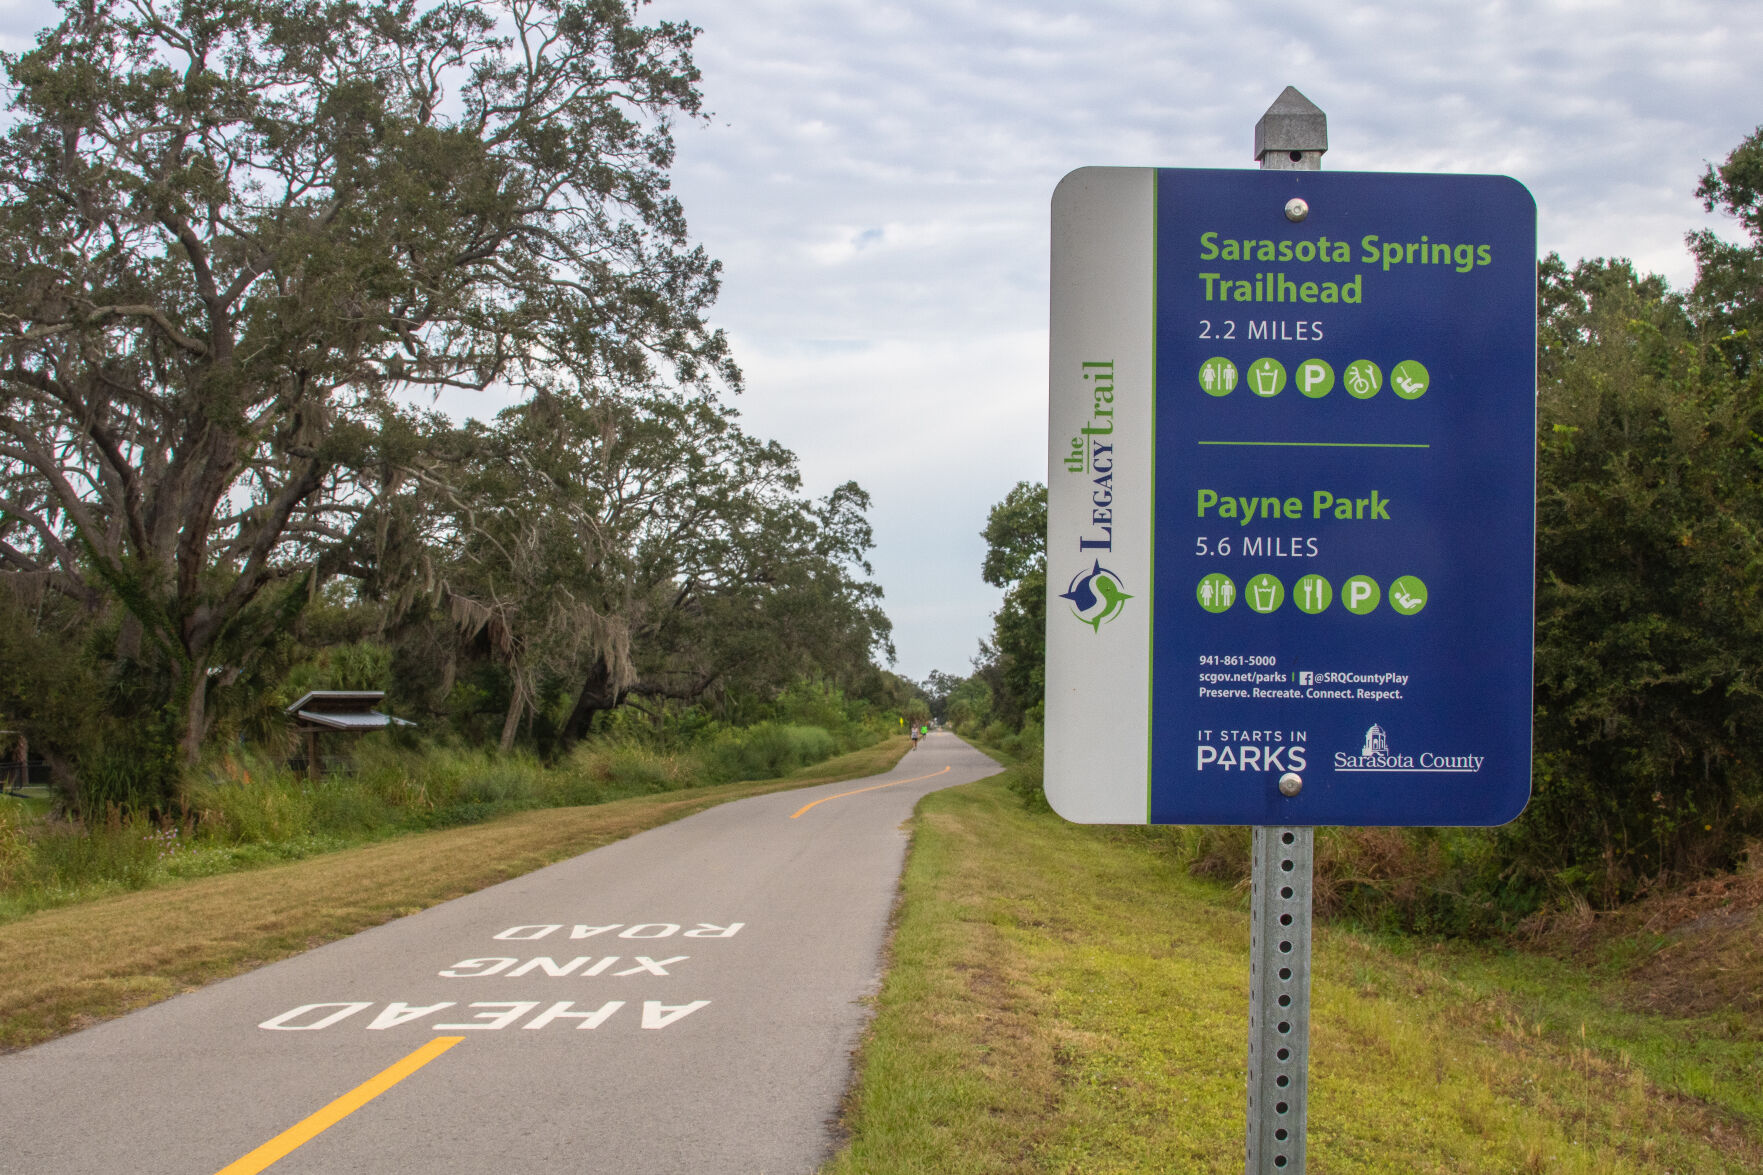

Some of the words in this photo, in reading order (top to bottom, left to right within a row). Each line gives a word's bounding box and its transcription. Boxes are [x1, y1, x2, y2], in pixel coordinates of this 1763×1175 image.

[1199, 231, 1351, 263] Sarasota
[1361, 234, 1492, 273] Springs
[1198, 272, 1363, 304] Trailhead
[1198, 319, 1236, 340] 2.2
[1247, 320, 1324, 341] MILES
[1081, 358, 1114, 435] trail
[1064, 436, 1084, 475] the
[1197, 488, 1303, 527] Payne
[1313, 489, 1391, 520] Park
[1195, 536, 1232, 557] 5.6
[1242, 537, 1319, 558] MILES
[1199, 655, 1276, 666] 941-861-5000
[1199, 671, 1287, 684] scgov.net/parks
[1314, 672, 1409, 686] @SRQCountyPlay
[1199, 687, 1250, 698] Preserve.
[1252, 687, 1304, 699] Recreate.
[1306, 688, 1355, 699] Connect.
[1357, 688, 1403, 701] Respect.
[1198, 730, 1213, 741] IT
[1220, 730, 1283, 742] STARTS
[1290, 731, 1307, 742] IN
[1197, 745, 1307, 772] PARKS
[1334, 751, 1414, 768] Sarasota
[1419, 752, 1485, 772] County
[492, 922, 745, 940] ROAD
[438, 955, 690, 978] XING
[258, 1000, 712, 1031] AHEAD
